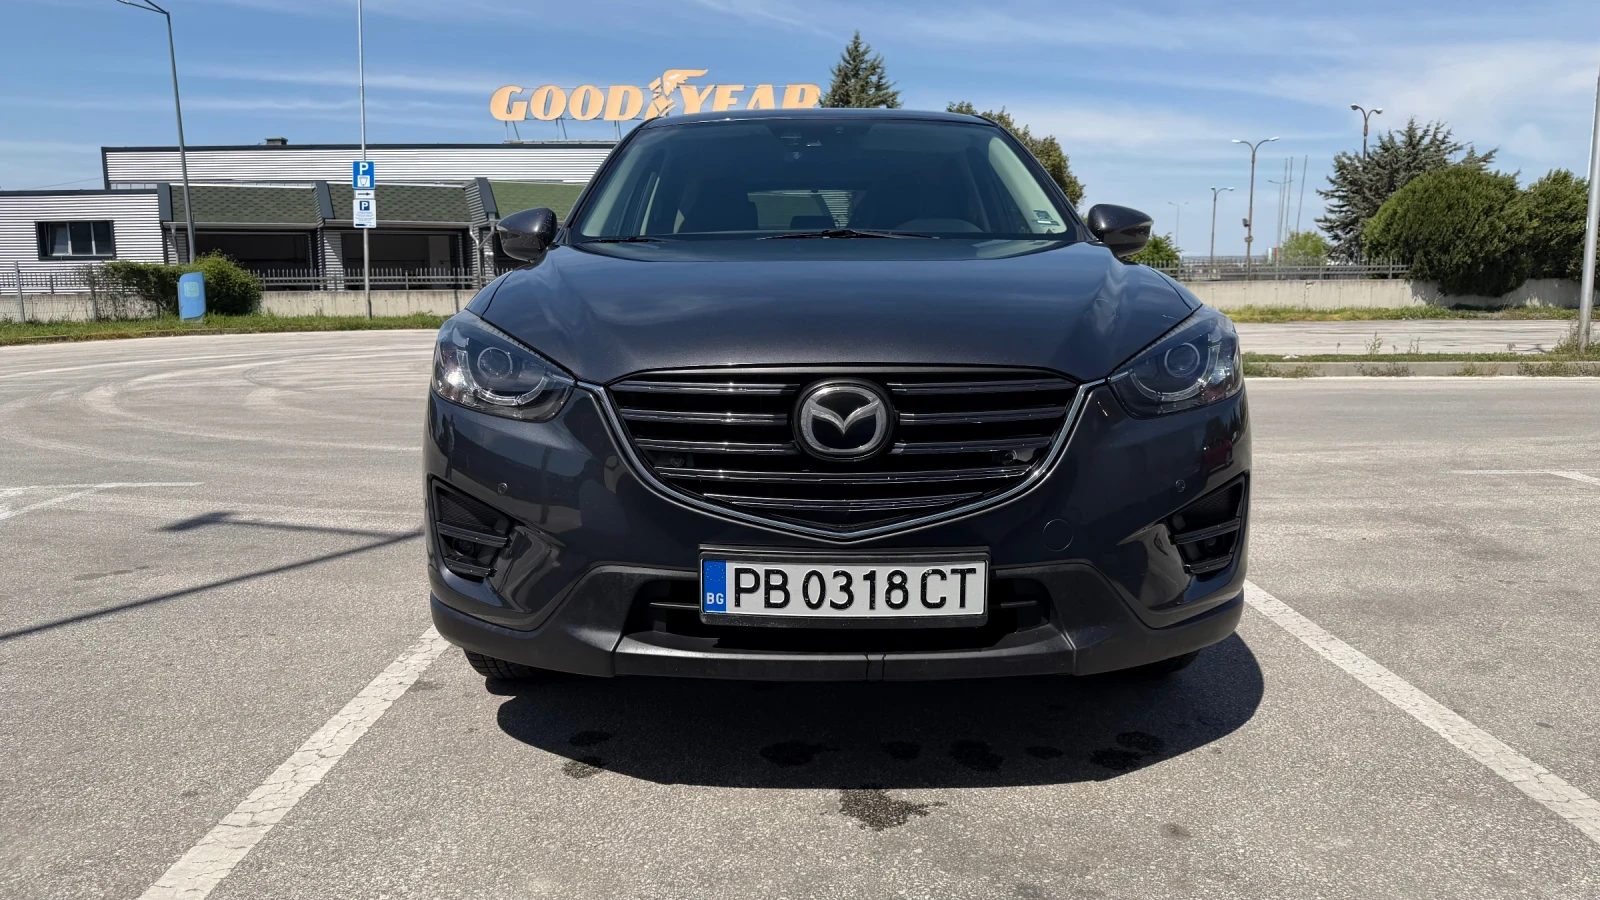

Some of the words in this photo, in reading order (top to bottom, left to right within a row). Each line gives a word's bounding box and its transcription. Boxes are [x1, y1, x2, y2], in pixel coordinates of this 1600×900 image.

[359, 162, 369, 175] P
[361, 201, 368, 211] P
[734, 567, 791, 609] PB
[802, 569, 909, 611] 0318
[920, 568, 977, 609] CT
[706, 593, 724, 605] BG
